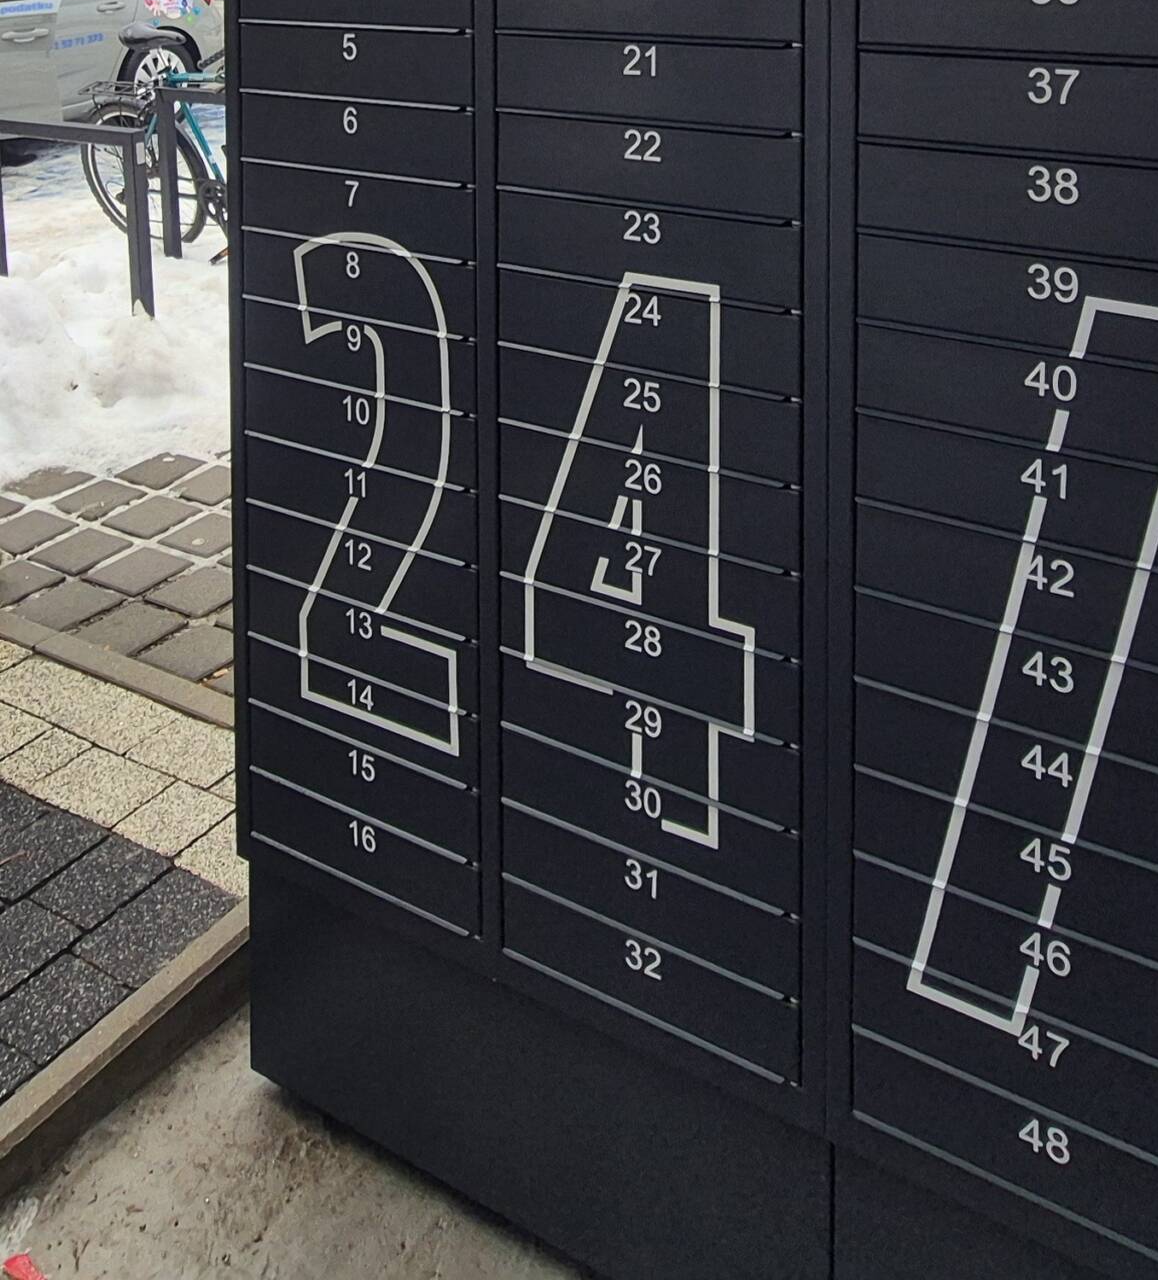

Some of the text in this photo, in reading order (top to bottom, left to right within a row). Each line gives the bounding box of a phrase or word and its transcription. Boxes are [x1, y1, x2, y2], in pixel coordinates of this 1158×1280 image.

[342, 33, 357, 61] 5
[623, 44, 656, 77] 21
[1027, 67, 1080, 105] 37
[343, 106, 358, 134] 6
[624, 128, 662, 162] 22
[344, 180, 359, 207] 7
[1027, 165, 1079, 205] 38
[623, 210, 661, 244] 23
[346, 251, 360, 279] 8
[1027, 263, 1079, 303] 39
[624, 291, 662, 327] 24
[346, 324, 361, 351] 9
[623, 377, 661, 413] 25
[1024, 361, 1077, 402] 40
[342, 395, 370, 425] 10
[344, 468, 366, 498] 11
[624, 459, 662, 495] 26
[1020, 458, 1067, 500] 41
[344, 539, 372, 571] 12
[625, 541, 662, 577] 27
[1025, 553, 1074, 598] 42
[345, 608, 373, 639] 13
[624, 620, 662, 657] 28
[1022, 651, 1074, 694] 43
[347, 679, 374, 711] 14
[624, 700, 662, 738] 29
[348, 749, 375, 782] 15
[1021, 744, 1073, 788] 44
[624, 780, 661, 819] 30
[349, 820, 376, 853] 16
[1020, 838, 1072, 881] 45
[624, 858, 658, 899] 31
[625, 939, 662, 981] 32
[1019, 932, 1071, 977] 46
[1018, 1025, 1070, 1068] 47
[1018, 1119, 1070, 1164] 48
